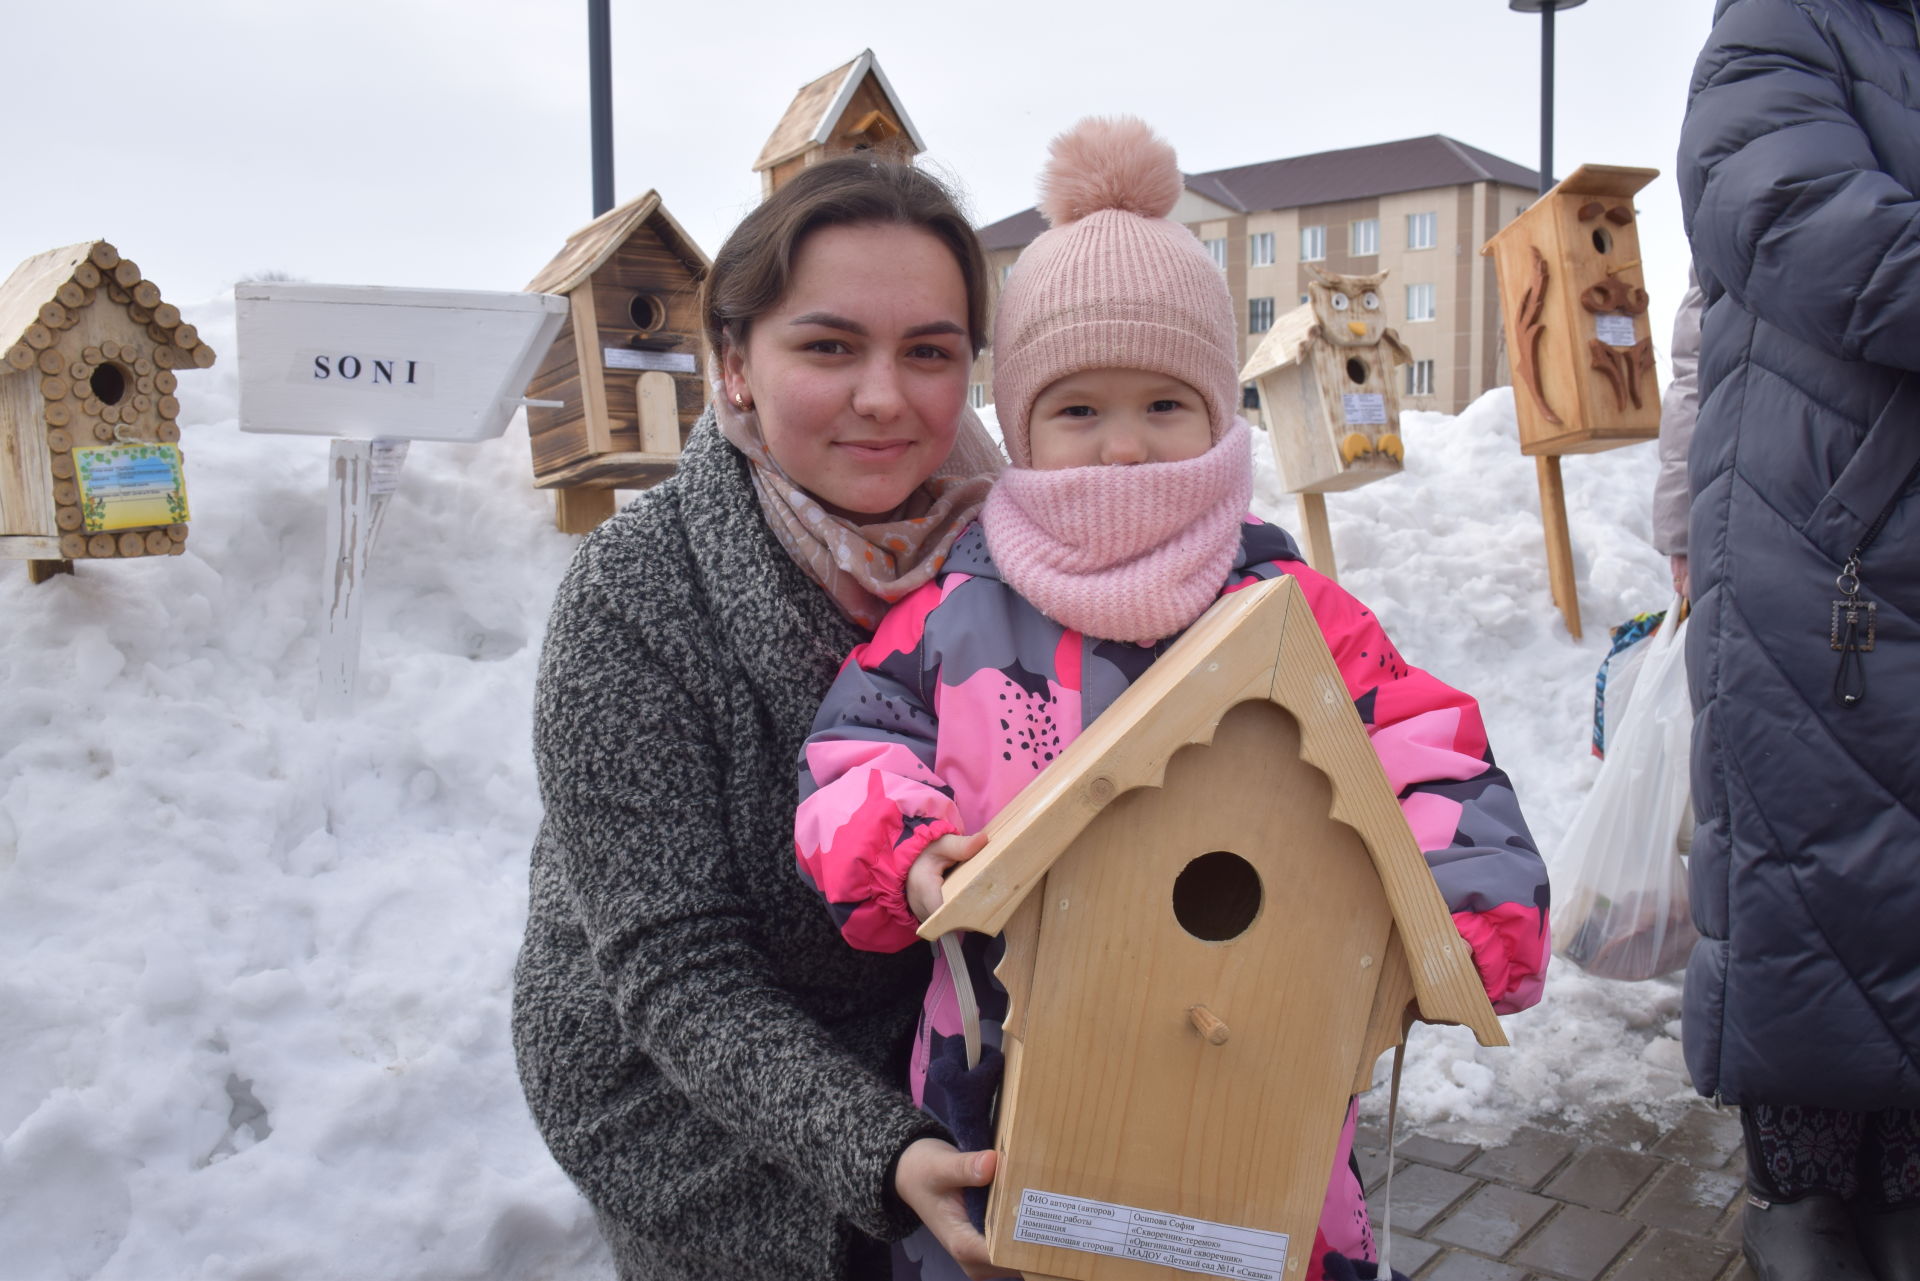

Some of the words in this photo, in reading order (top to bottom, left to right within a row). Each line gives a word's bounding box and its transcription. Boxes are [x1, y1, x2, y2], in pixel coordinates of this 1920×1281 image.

[314, 355, 417, 384] SONI
[1025, 1207, 1062, 1220] Название
[1063, 1216, 1092, 1226] работы
[1027, 1194, 1048, 1205] ФИО
[1050, 1200, 1076, 1211] автора
[1077, 1203, 1115, 1217] (авторов)
[1023, 1220, 1066, 1233] номинация
[1133, 1213, 1167, 1226] Осипова
[1169, 1219, 1195, 1231] София
[1020, 1229, 1081, 1247] Направляющая
[1082, 1243, 1114, 1252] сторона
[1129, 1238, 1192, 1255] «Оригинальный
[1193, 1249, 1243, 1263] скворечник»
[1127, 1247, 1162, 1260] МАДОУ
[1163, 1254, 1200, 1267] «Детский
[1201, 1262, 1215, 1271] сад
[1236, 1267, 1273, 1280] «Сказка»
